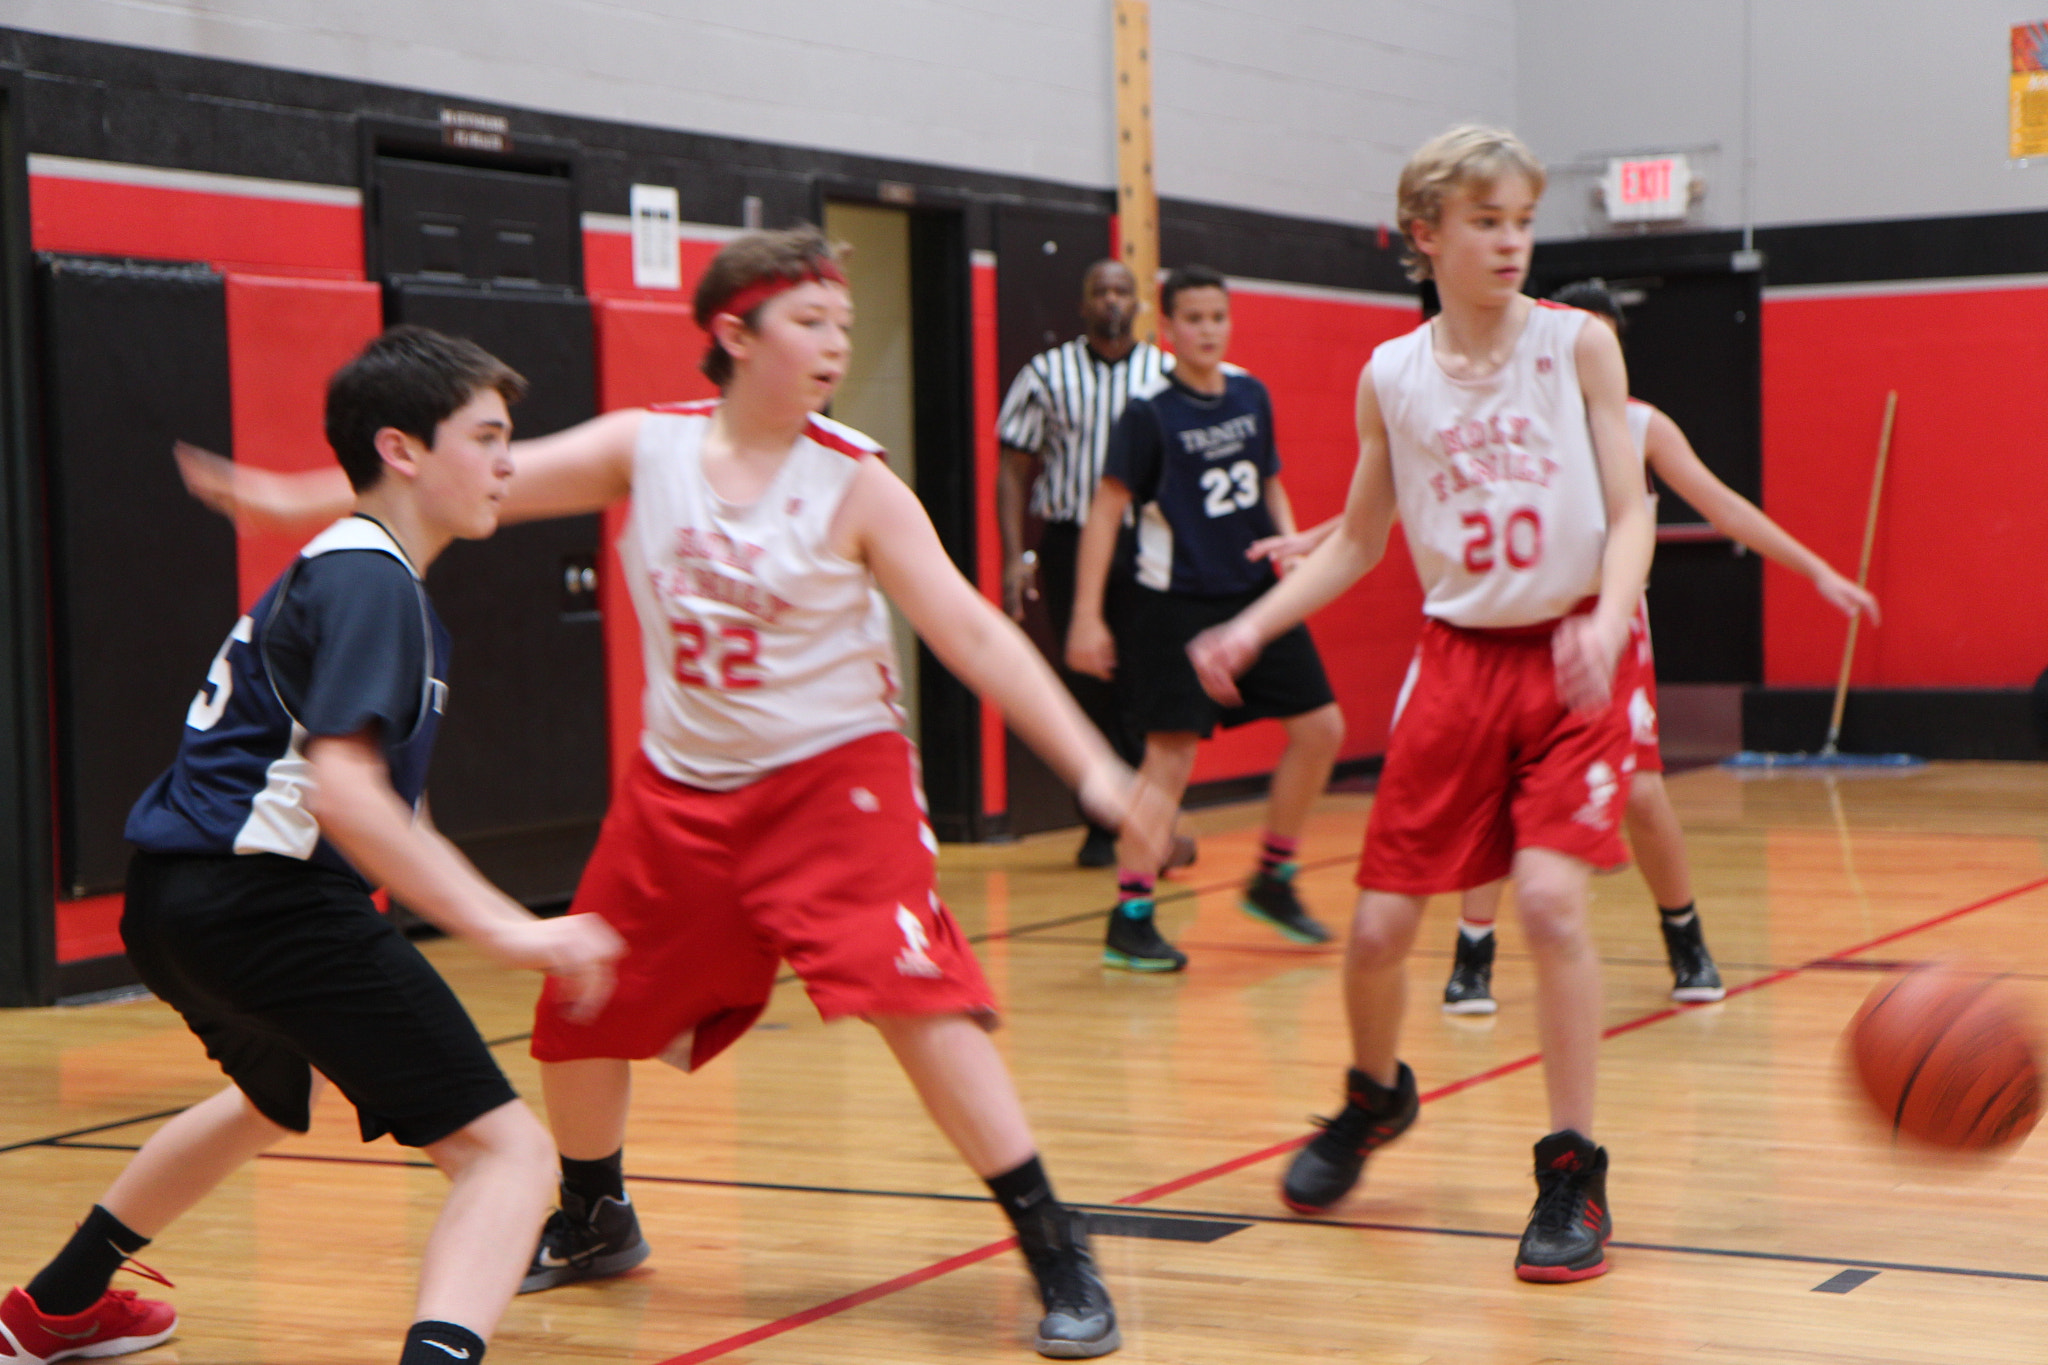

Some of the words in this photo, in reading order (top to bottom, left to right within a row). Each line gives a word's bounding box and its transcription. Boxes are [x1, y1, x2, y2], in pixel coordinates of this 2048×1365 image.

[1621, 159, 1674, 204] EXIT
[1200, 460, 1259, 519] 23
[1461, 506, 1544, 574] 20
[670, 618, 762, 689] 22
